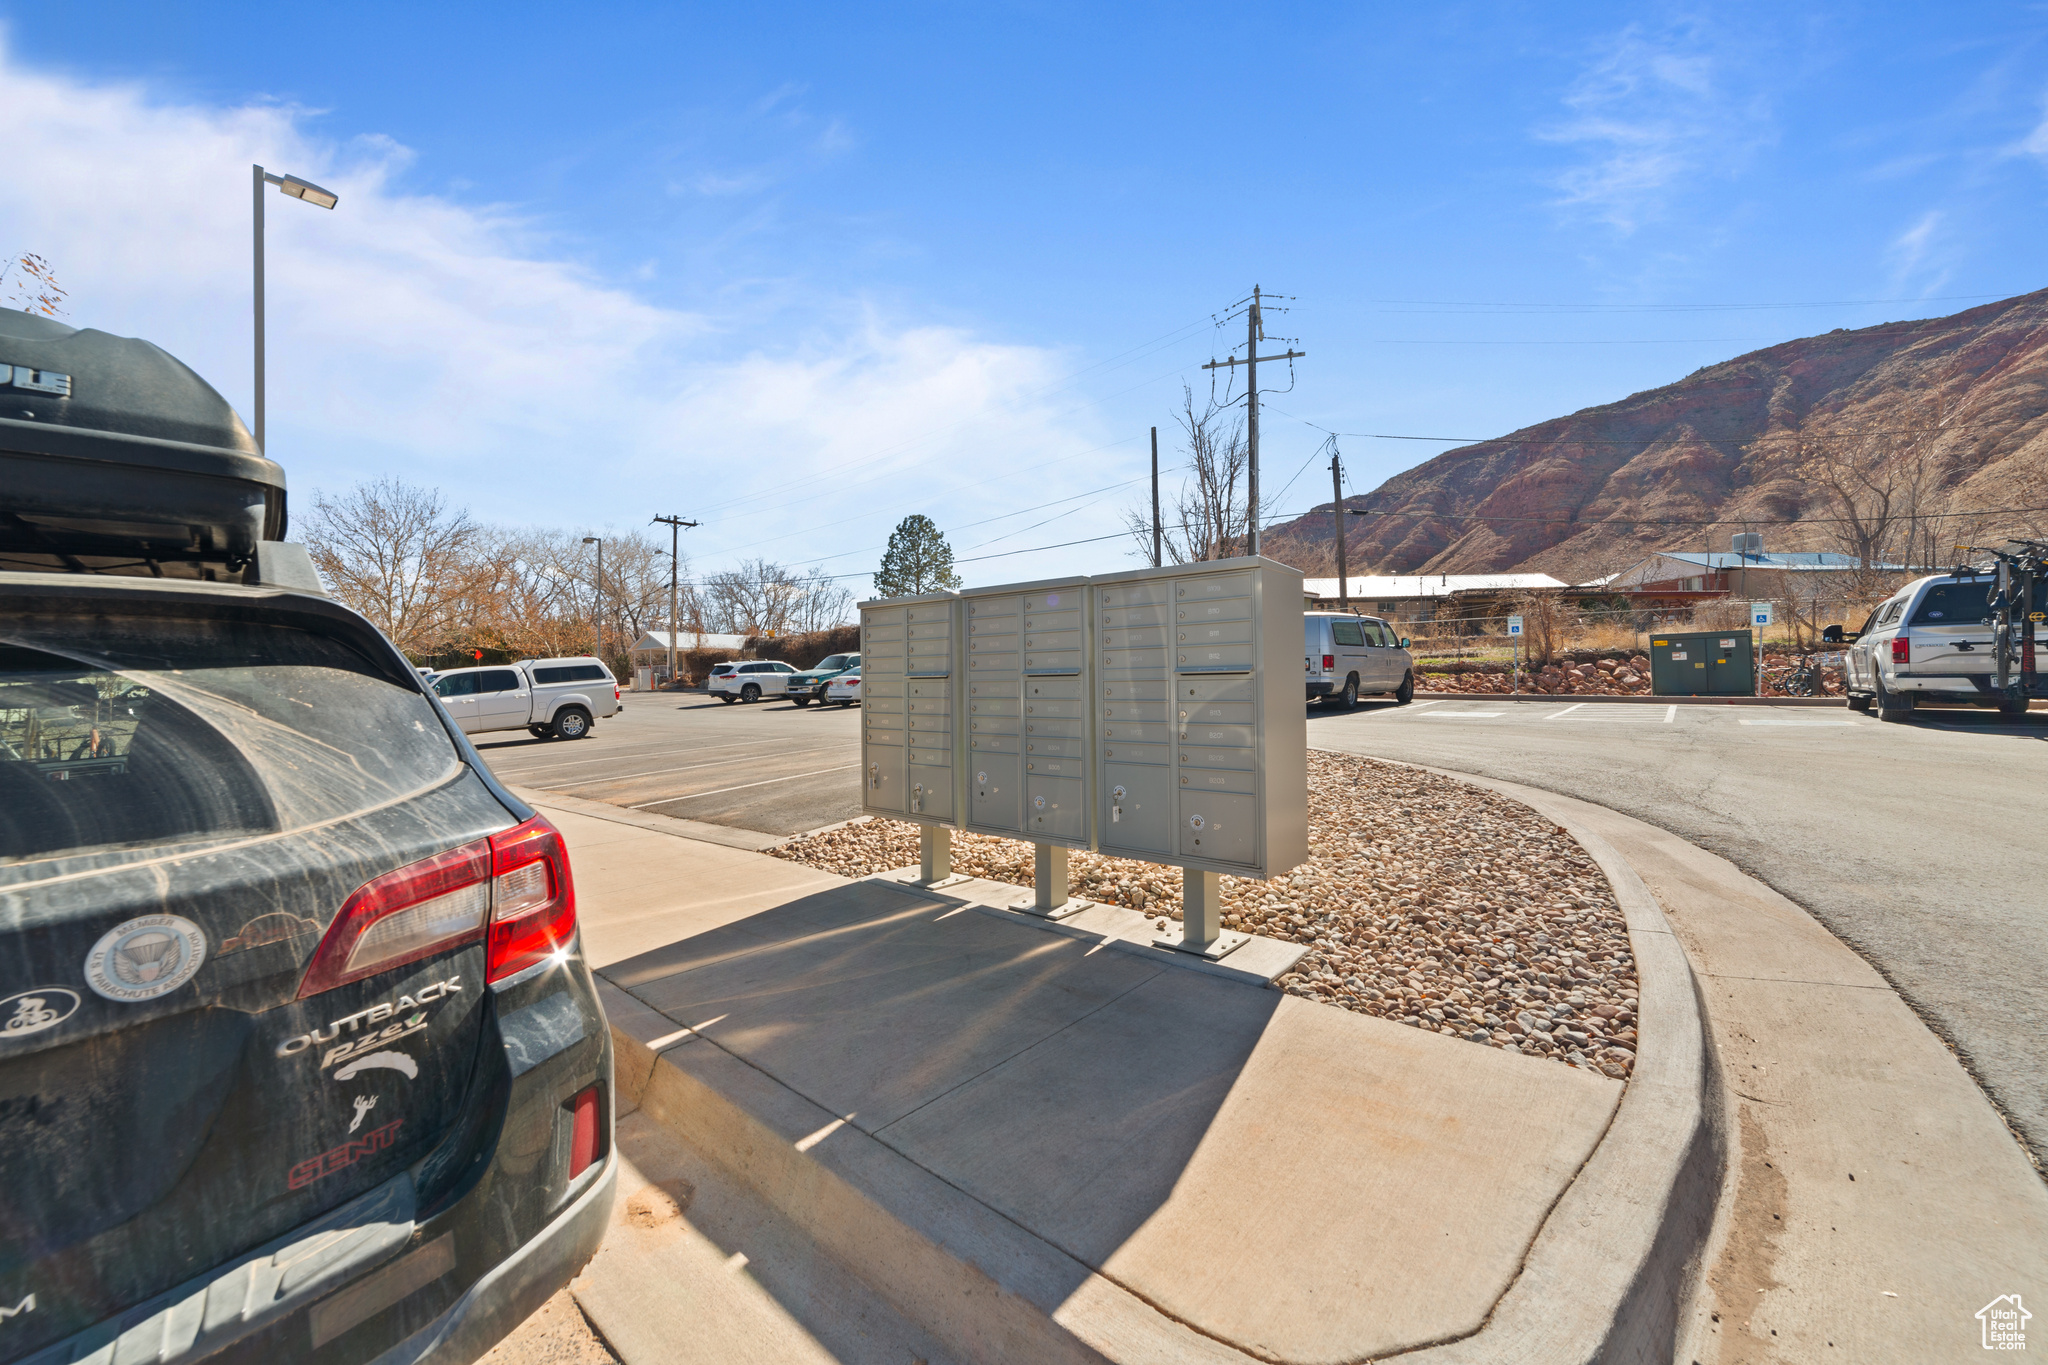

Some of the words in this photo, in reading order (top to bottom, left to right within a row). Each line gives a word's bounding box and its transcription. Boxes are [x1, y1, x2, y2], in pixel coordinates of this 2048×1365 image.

[1213, 823, 1222, 831] 2P
[117, 918, 174, 936] MEMBER
[163, 931, 202, 990] ASSOCIATION
[276, 975, 462, 1058] OUTBACK
[288, 1118, 404, 1190] SENT
